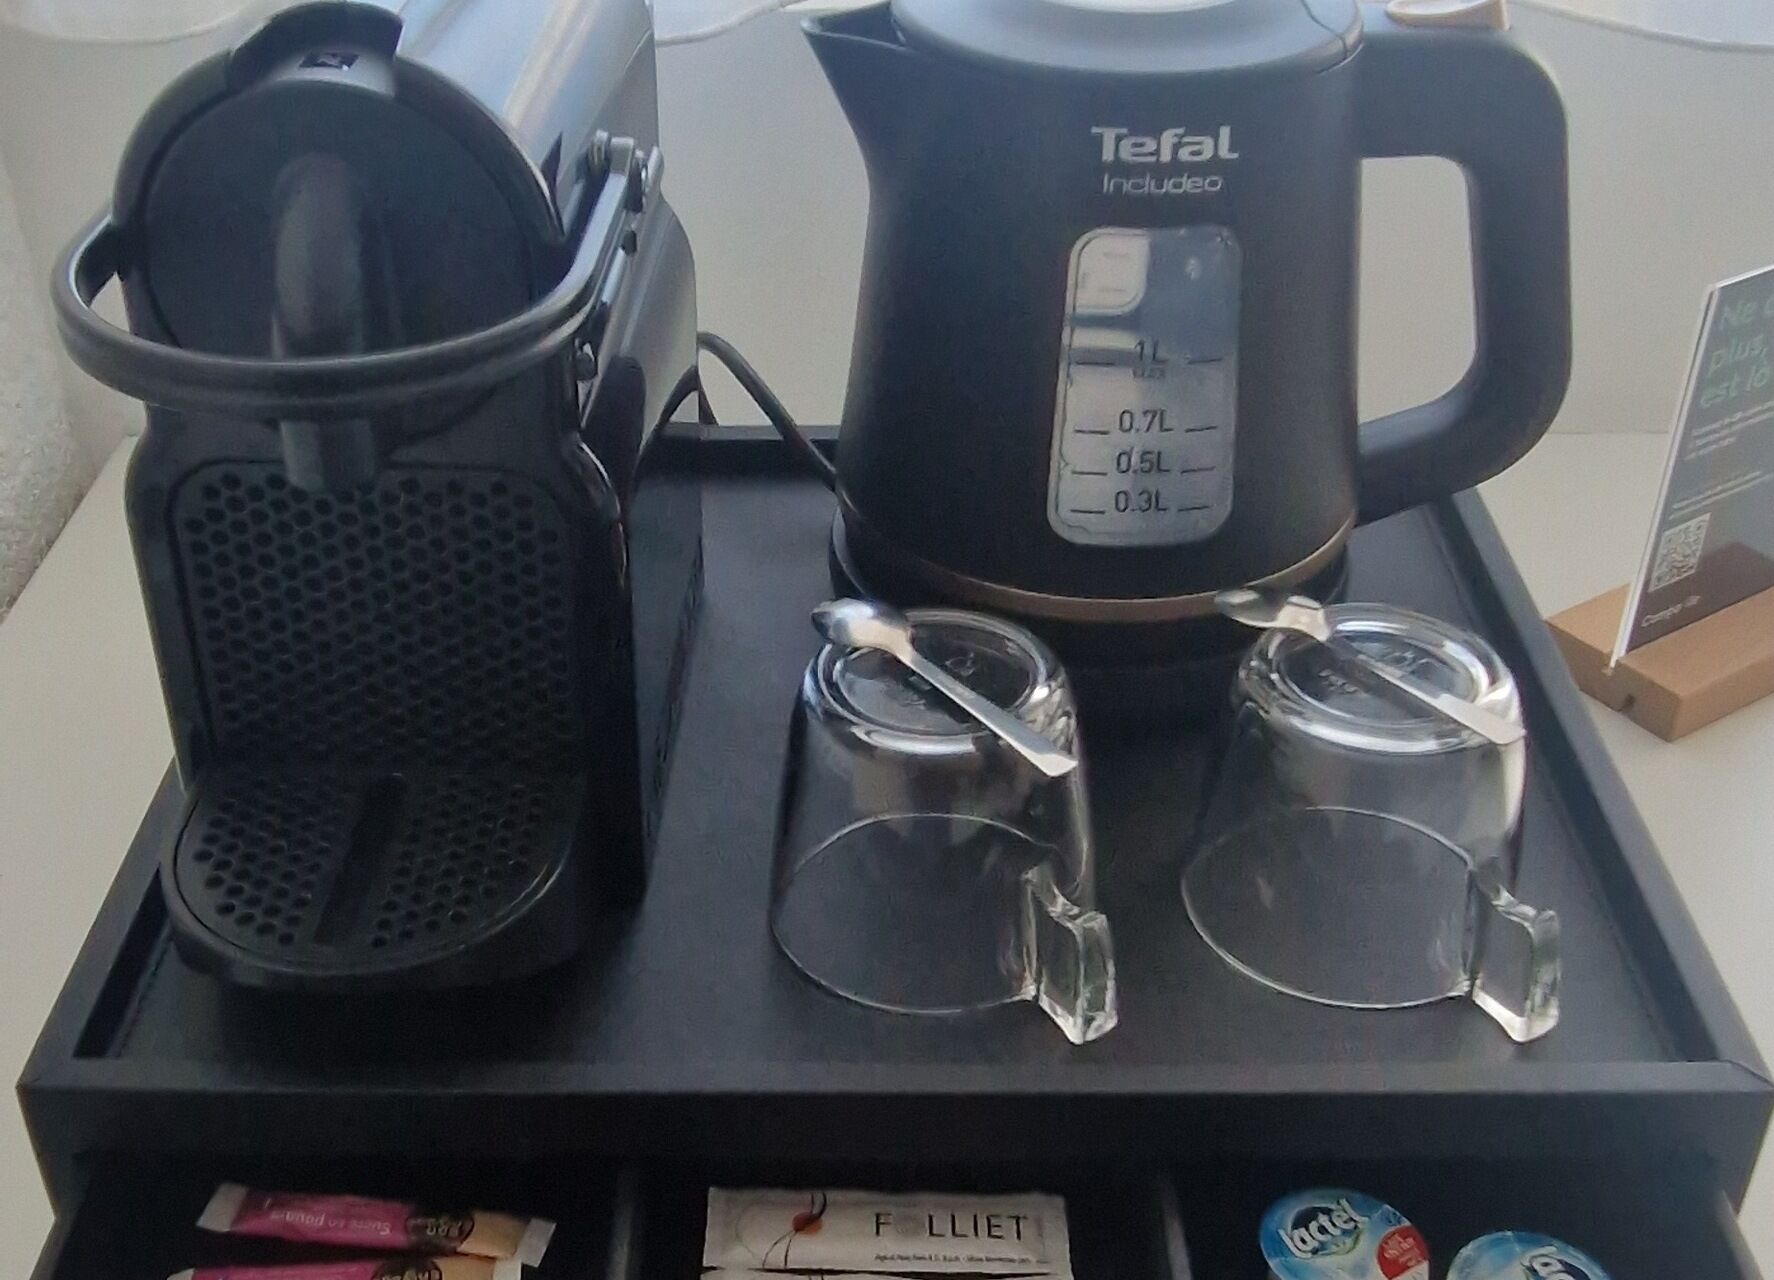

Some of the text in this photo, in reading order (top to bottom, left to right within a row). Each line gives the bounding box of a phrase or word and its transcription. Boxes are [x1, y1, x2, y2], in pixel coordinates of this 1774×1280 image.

[1091, 126, 1239, 163] Tefal
[1103, 172, 1223, 196] Includeo
[1118, 409, 1174, 434] 0.7L
[1116, 451, 1171, 475] 0.5L
[1114, 489, 1168, 513] 0.3L
